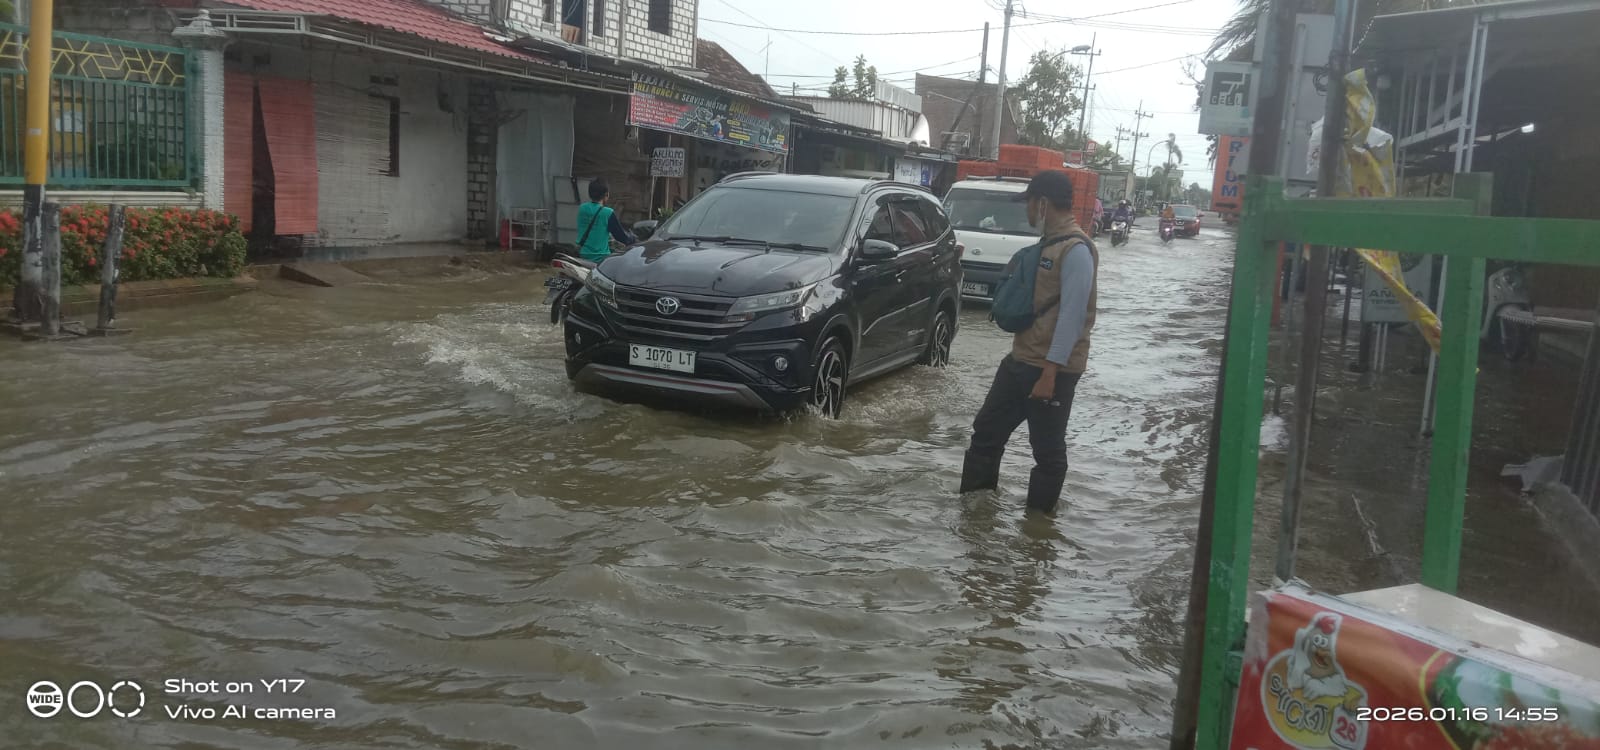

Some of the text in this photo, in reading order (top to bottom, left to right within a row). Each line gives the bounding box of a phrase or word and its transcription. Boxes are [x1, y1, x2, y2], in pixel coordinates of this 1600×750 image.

[682, 94, 705, 106] SERVIS
[632, 346, 693, 365] S 1070 LT
[1335, 716, 1357, 743] 28
